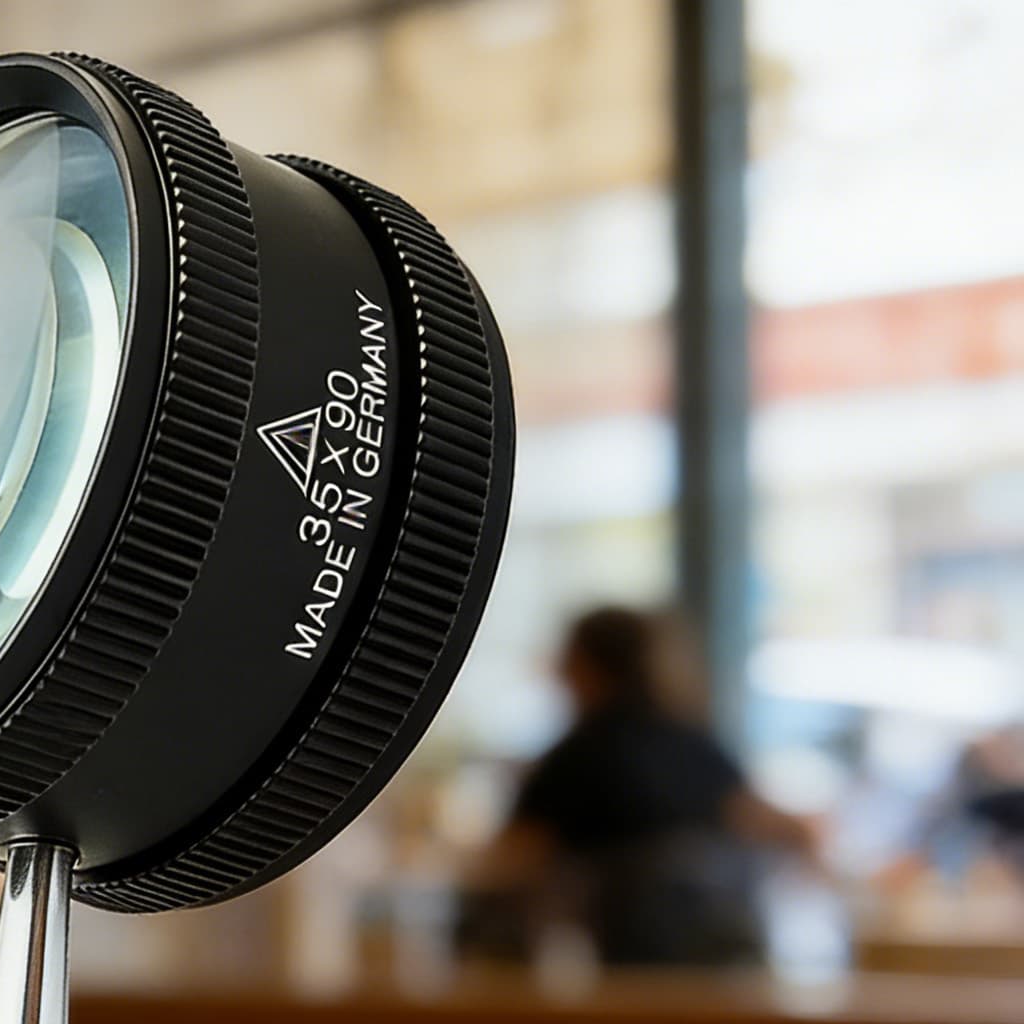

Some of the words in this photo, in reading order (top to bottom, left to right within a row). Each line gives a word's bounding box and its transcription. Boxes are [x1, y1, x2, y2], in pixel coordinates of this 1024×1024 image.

[352, 288, 388, 477] GERMANY
[299, 479, 343, 547] 35
[326, 370, 359, 431] 90
[337, 488, 373, 530] IN
[284, 539, 356, 659] MADE
